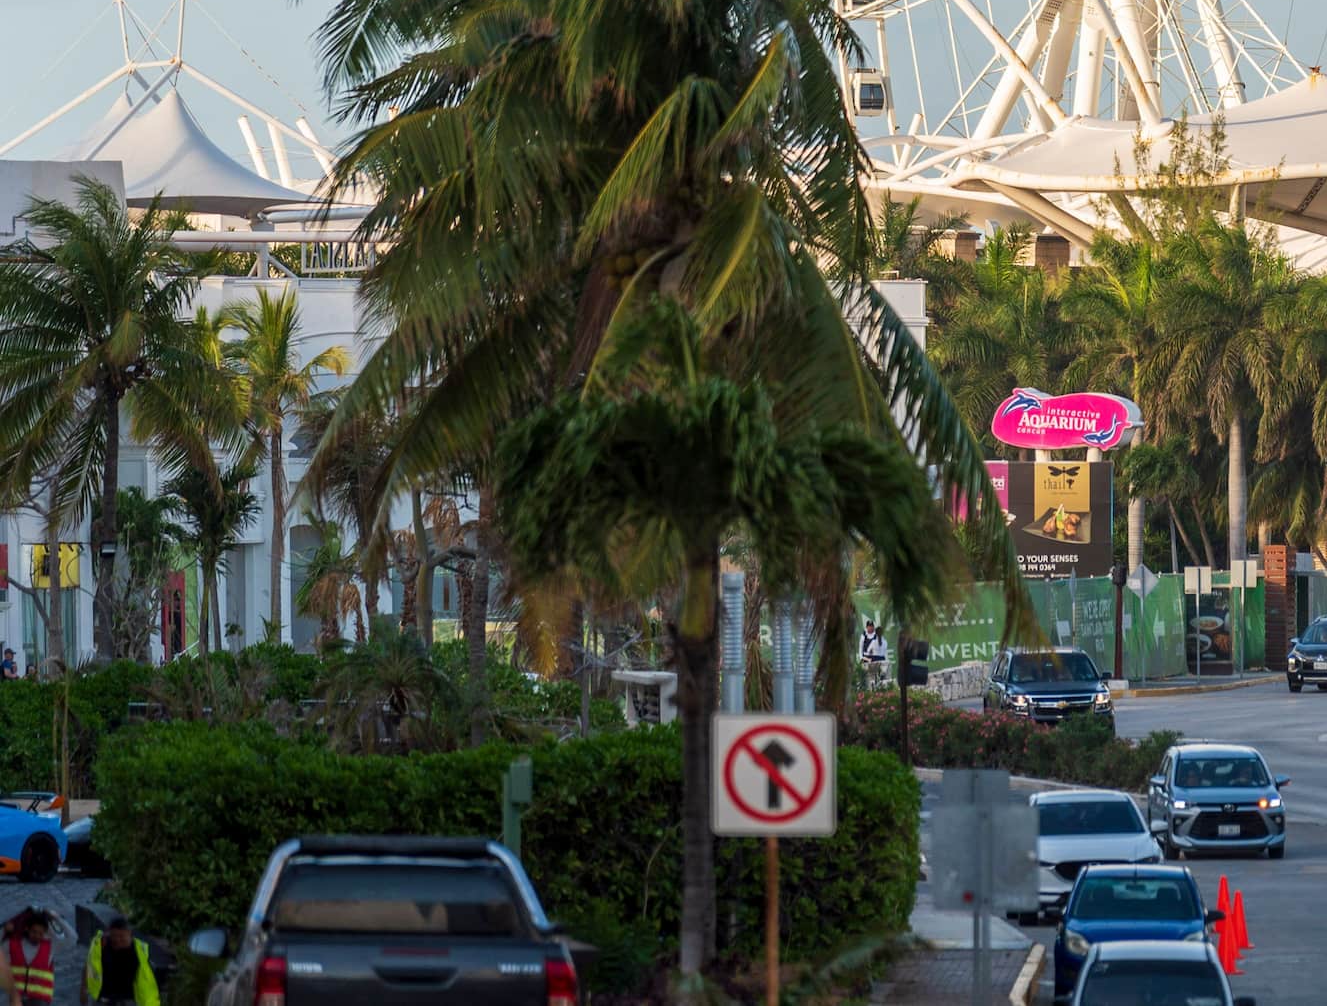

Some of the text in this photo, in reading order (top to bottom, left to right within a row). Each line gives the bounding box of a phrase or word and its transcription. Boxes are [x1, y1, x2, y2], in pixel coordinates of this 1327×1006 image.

[1047, 406, 1101, 419] interactive
[1018, 411, 1097, 432] AQUARIUM
[1026, 554, 1049, 563] YOUR
[1050, 554, 1079, 563] SENSES
